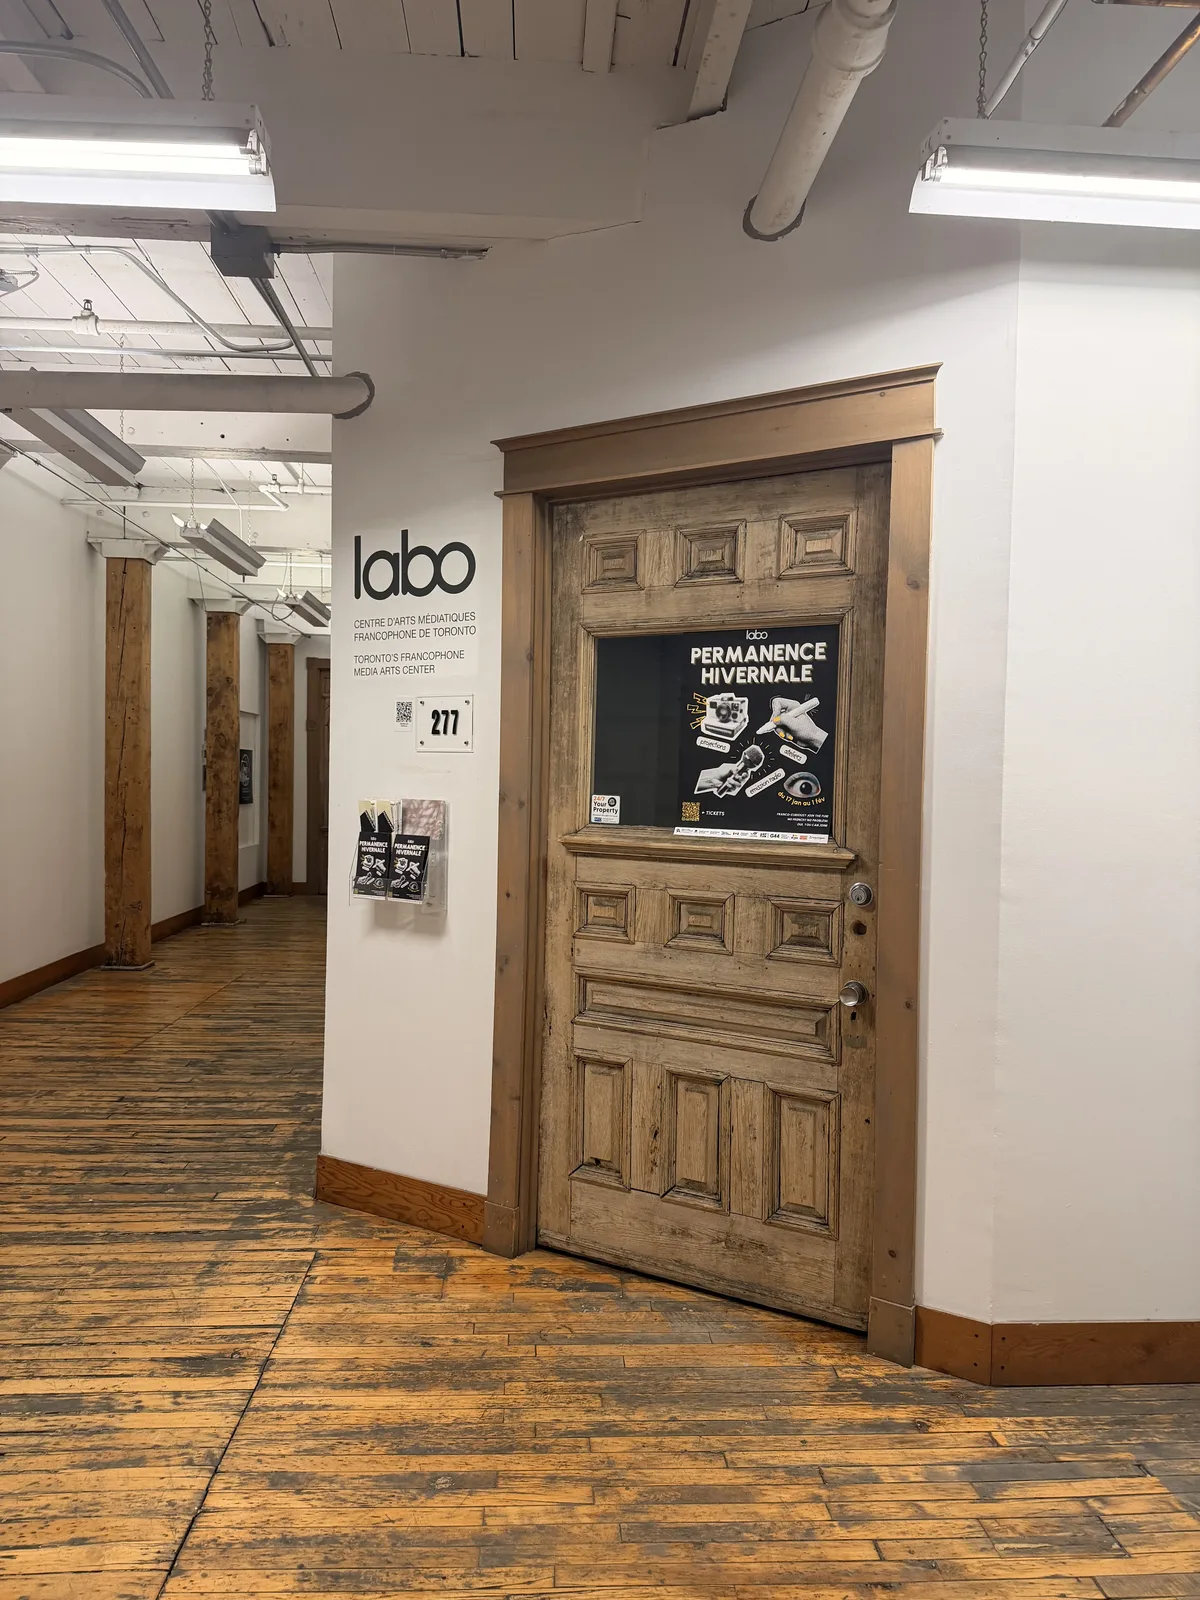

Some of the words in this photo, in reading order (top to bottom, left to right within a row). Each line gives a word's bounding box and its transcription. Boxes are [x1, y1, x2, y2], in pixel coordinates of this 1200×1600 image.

[354, 529, 476, 600] labo
[354, 618, 385, 628] CENTRE
[387, 616, 416, 627] D'ARTS
[418, 612, 476, 624] MÉDIATIQUES
[354, 629, 416, 642] FRANCOPHONE
[419, 629, 430, 638] DE
[433, 626, 476, 637] TORONTO
[746, 630, 768, 640] labo
[354, 653, 399, 664] TORONTO'S
[401, 650, 464, 662] FRANCOPHONE
[690, 642, 826, 664] PERMANENCE
[354, 667, 378, 676] MEDIA
[380, 666, 400, 675] ARTS
[402, 665, 435, 674] CENTER
[701, 664, 813, 684] HIVERNALE
[431, 710, 459, 735] 277
[700, 739, 726, 750] projections
[784, 748, 802, 760] ateliers
